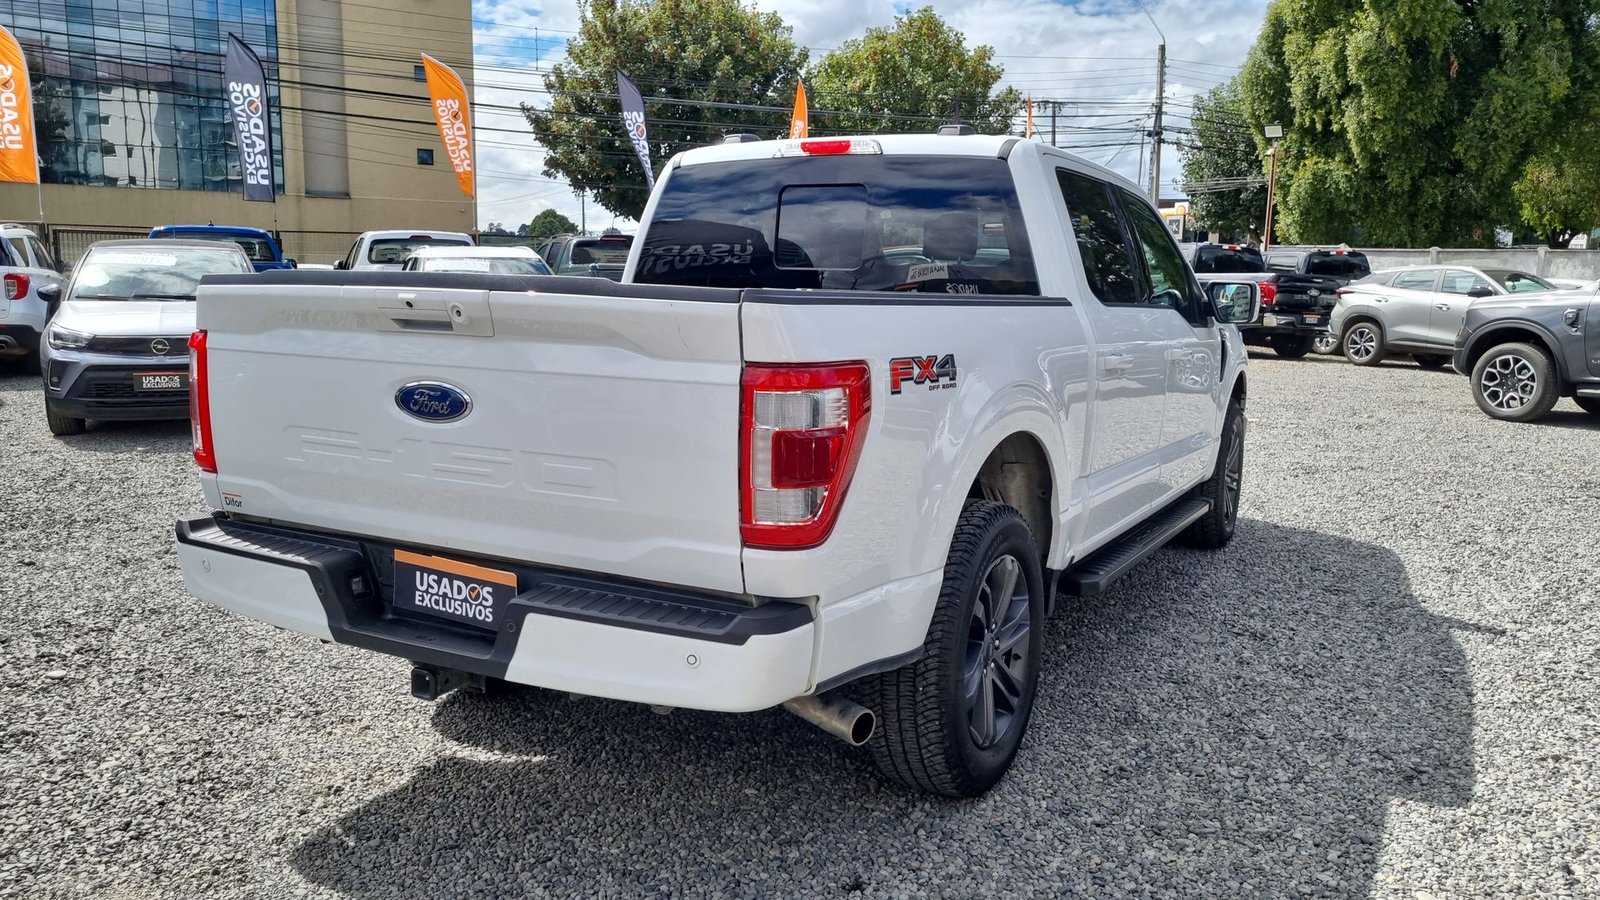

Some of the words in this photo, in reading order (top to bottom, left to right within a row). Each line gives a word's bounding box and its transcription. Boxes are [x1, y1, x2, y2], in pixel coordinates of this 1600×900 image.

[142, 375, 180, 383] USADOS
[889, 353, 957, 395] FX4
[410, 389, 451, 414] Ford
[225, 496, 242, 507] Difor
[415, 570, 494, 607] USADOS
[414, 590, 494, 623] EXCLUSIVOS
